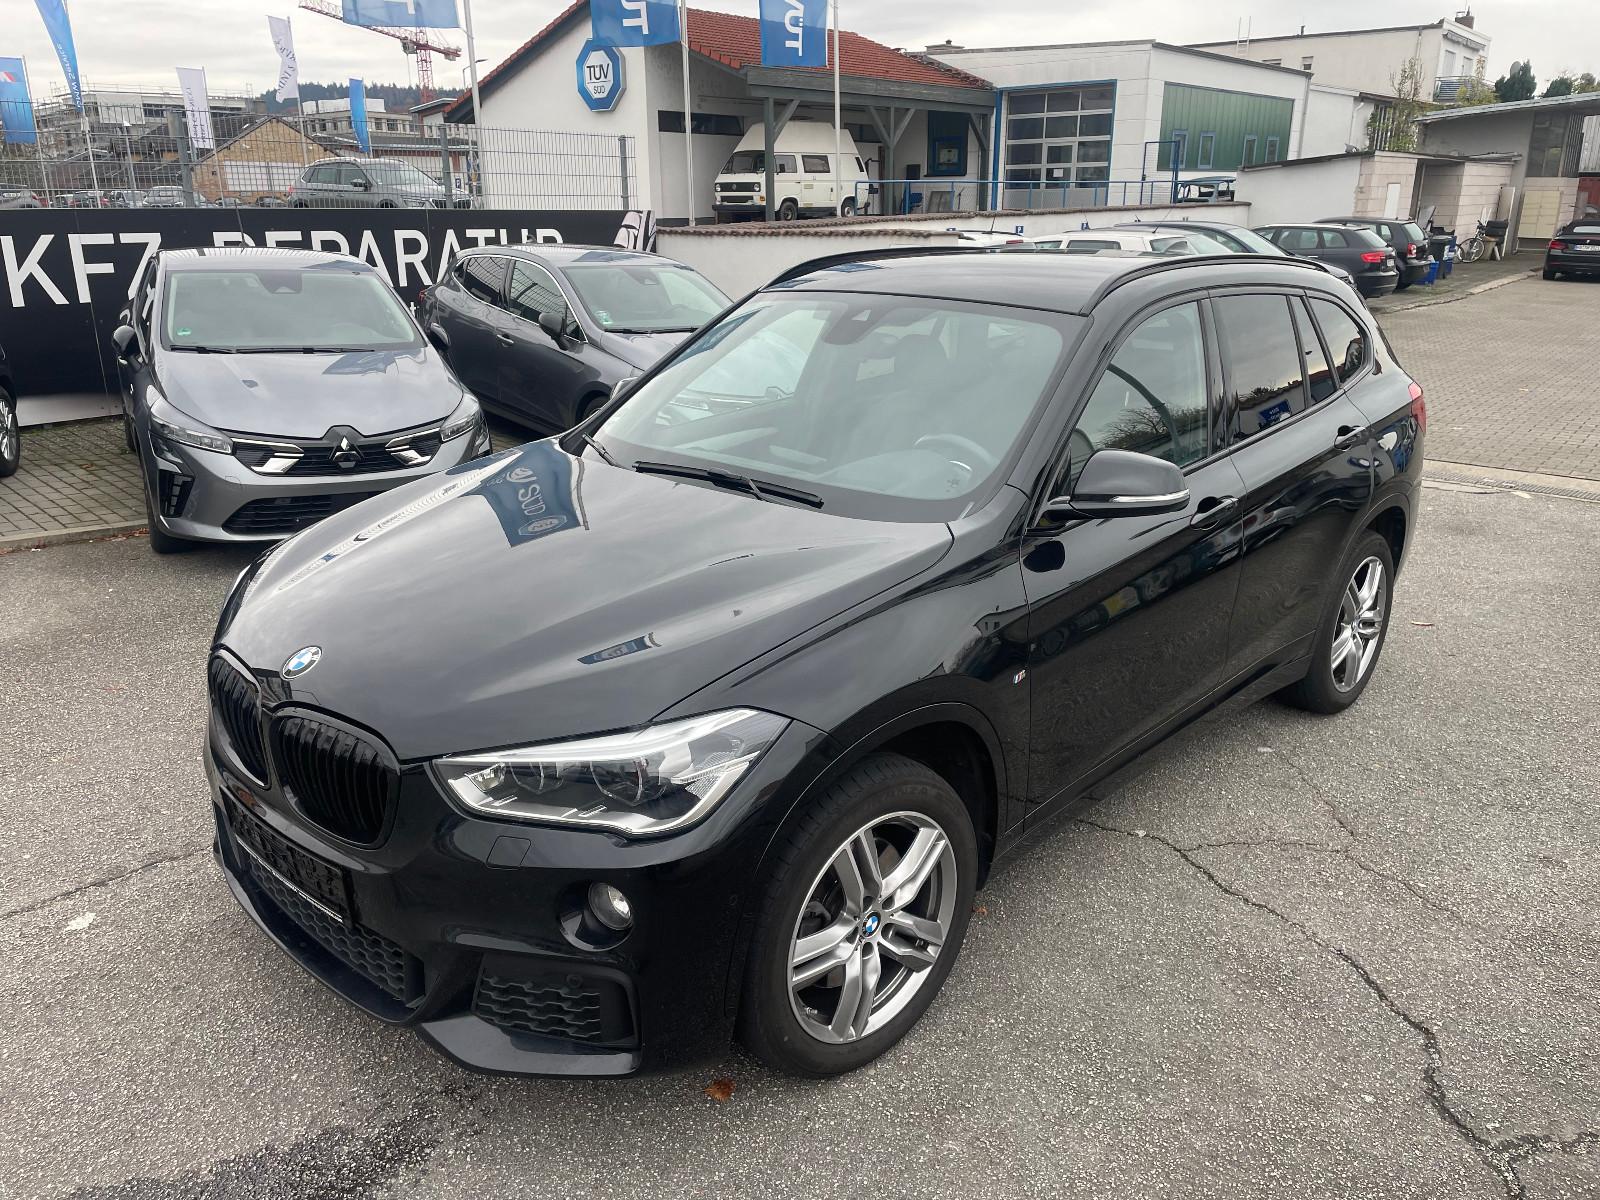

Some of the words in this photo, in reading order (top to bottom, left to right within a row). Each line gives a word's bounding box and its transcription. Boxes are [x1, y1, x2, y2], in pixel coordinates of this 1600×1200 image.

[586, 63, 610, 81] TÜV
[593, 85, 606, 94] SÜD
[0, 232, 162, 307] KFZ
[212, 228, 564, 288] PARAT
